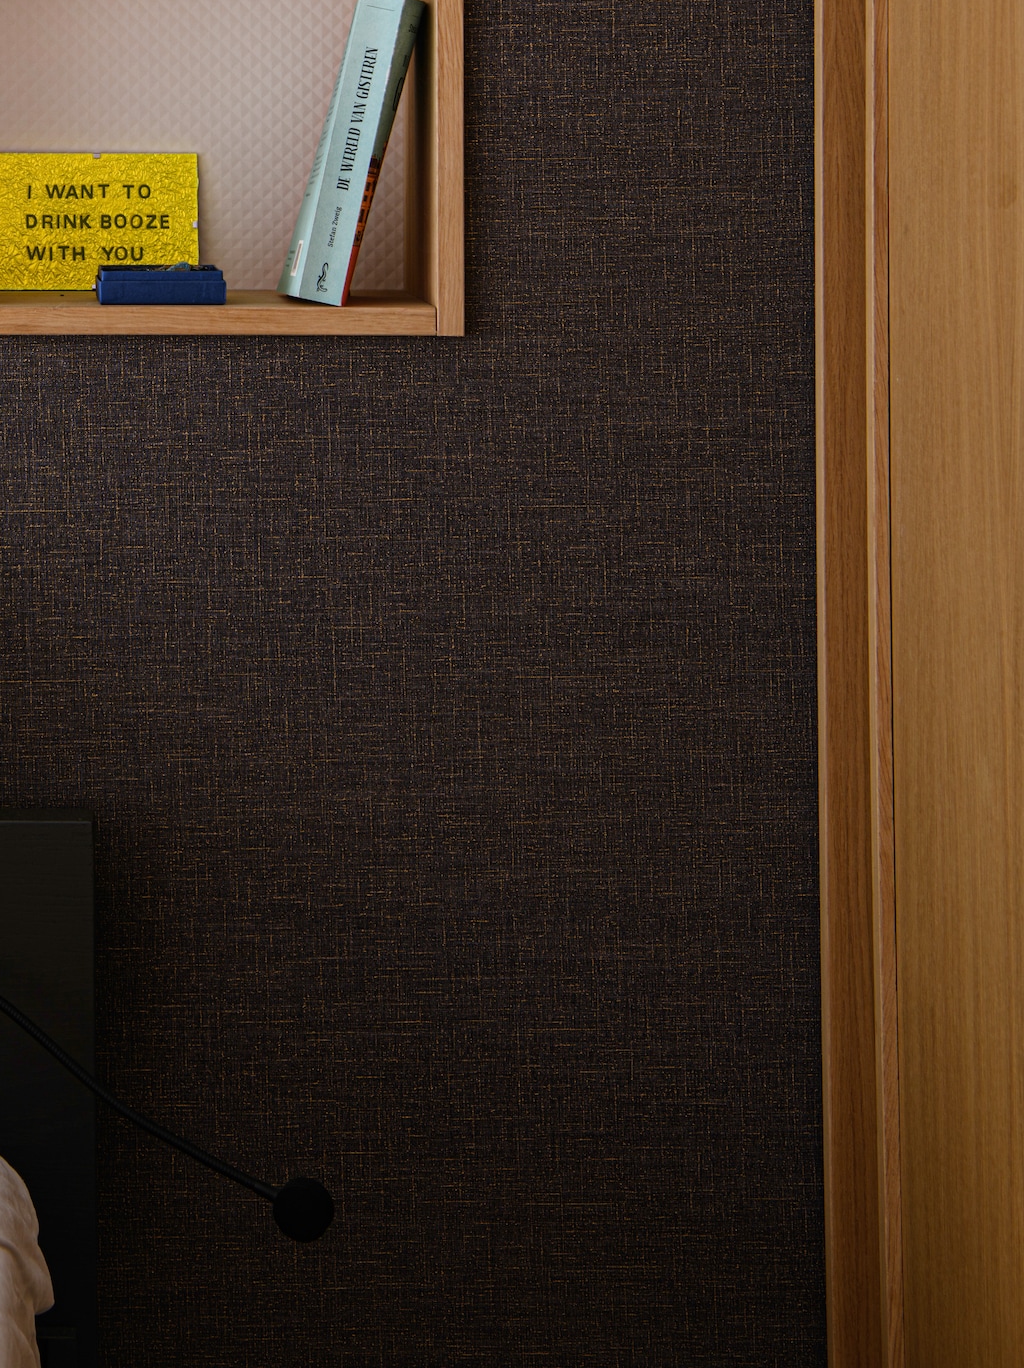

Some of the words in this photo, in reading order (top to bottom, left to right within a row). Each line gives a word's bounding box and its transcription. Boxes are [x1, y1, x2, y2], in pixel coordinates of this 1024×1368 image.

[356, 46, 378, 99] GISTEREN
[350, 102, 366, 124] VAN
[340, 127, 361, 172] WERELD
[27, 184, 32, 199] I
[45, 184, 110, 199] WANT
[123, 184, 151, 199] TO
[336, 176, 351, 191] DE
[26, 214, 92, 229] DRINK
[100, 214, 170, 230] BOOZE
[332, 206, 343, 225] Zweig
[327, 225, 338, 248] Stefan
[26, 245, 86, 261] WITH
[102, 246, 144, 261] YOU
